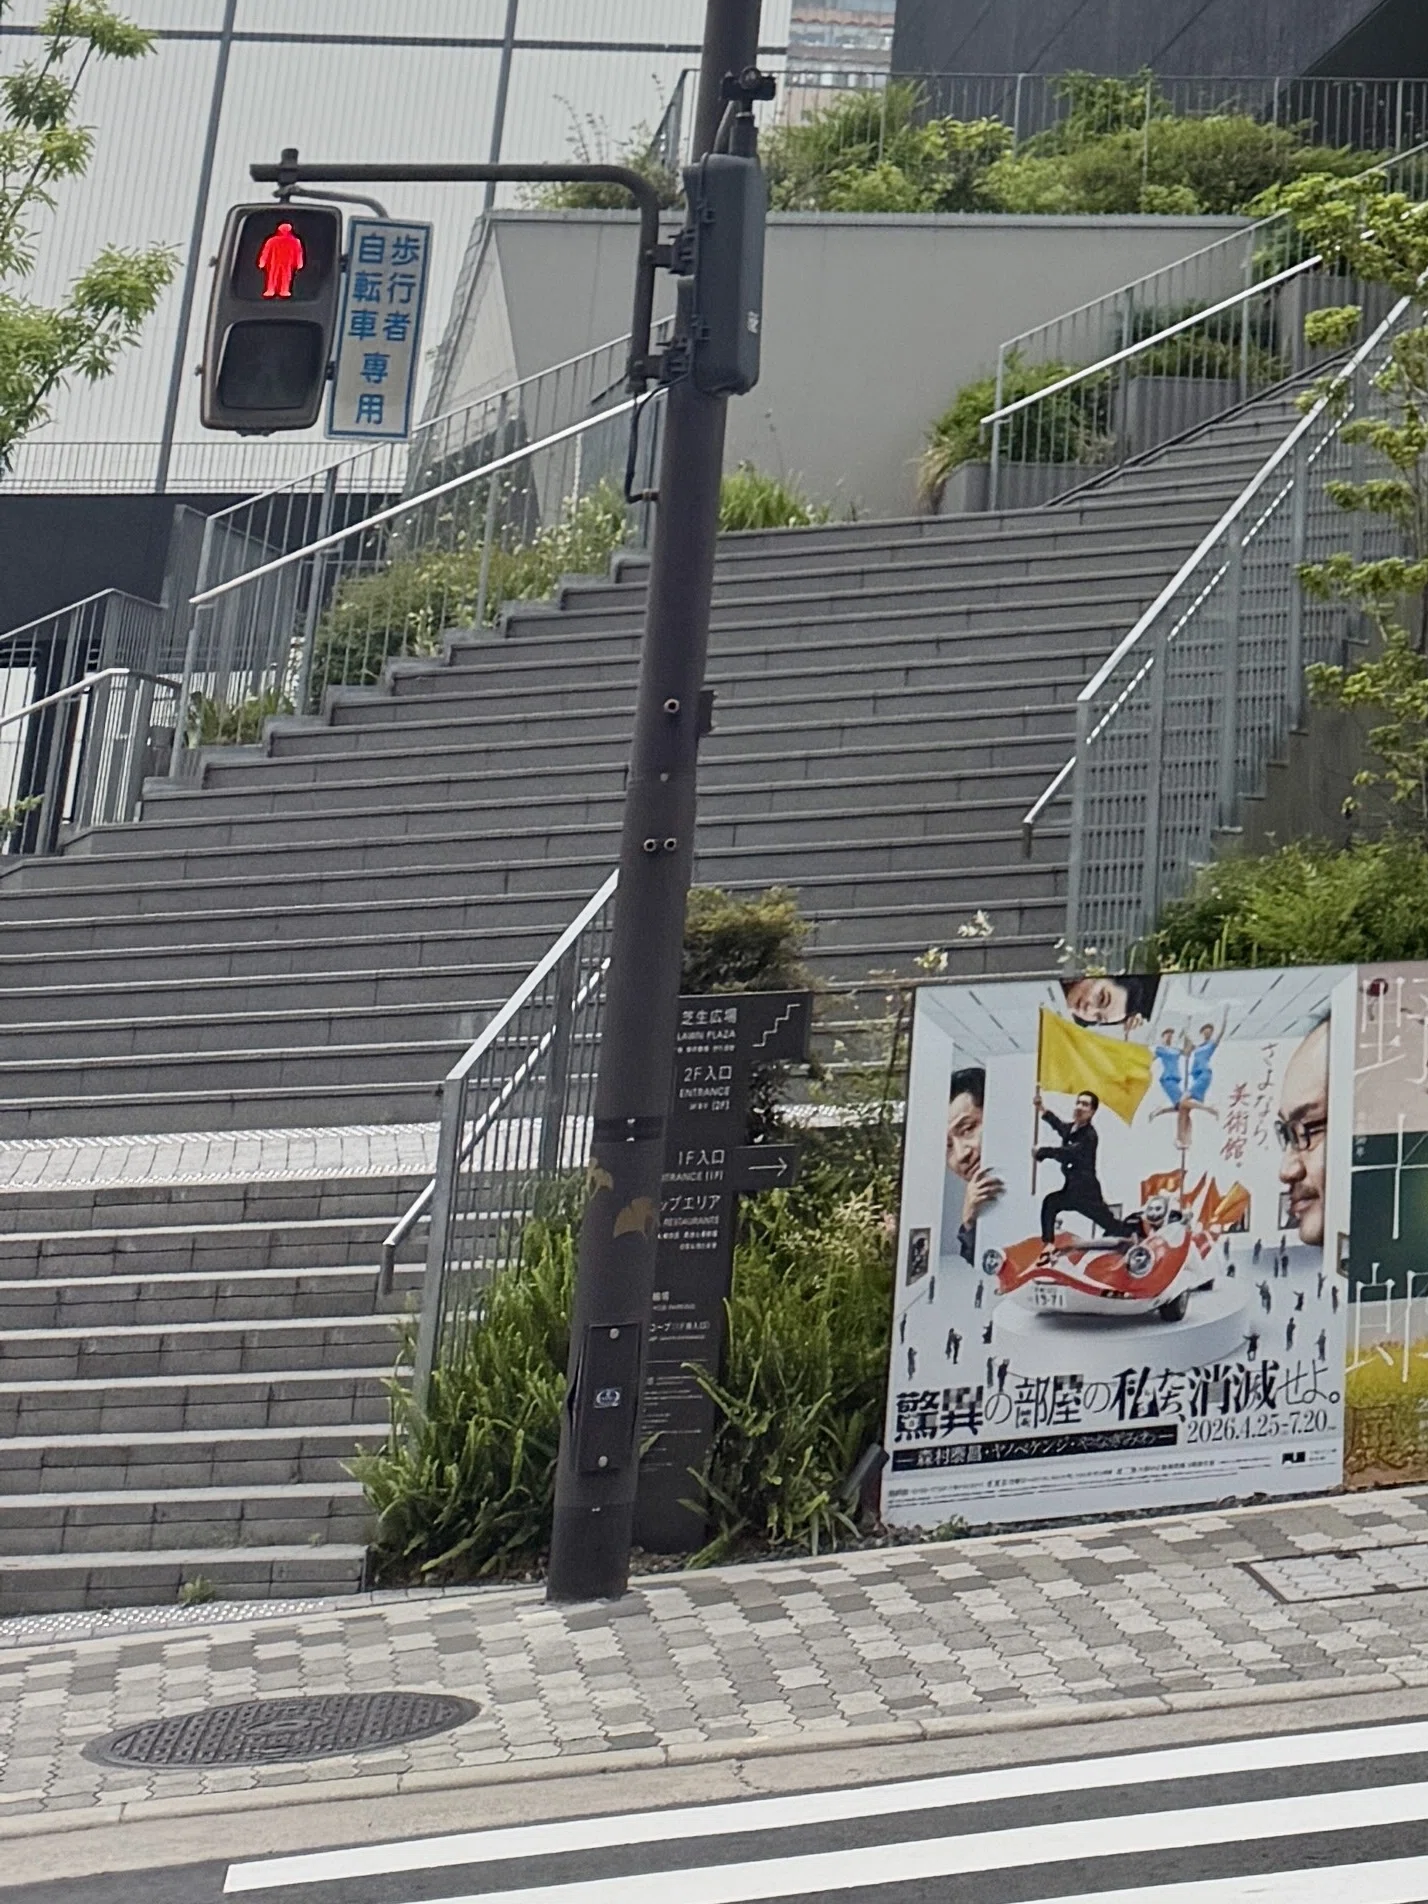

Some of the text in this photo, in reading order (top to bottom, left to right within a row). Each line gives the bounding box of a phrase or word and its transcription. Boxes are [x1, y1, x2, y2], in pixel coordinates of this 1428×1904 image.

[348, 233, 386, 341] 自転車
[383, 234, 420, 342] 歩行者
[355, 351, 391, 425] 専用
[678, 1085, 732, 1099] ENTRANCE
[660, 1171, 703, 1183] TRANCE
